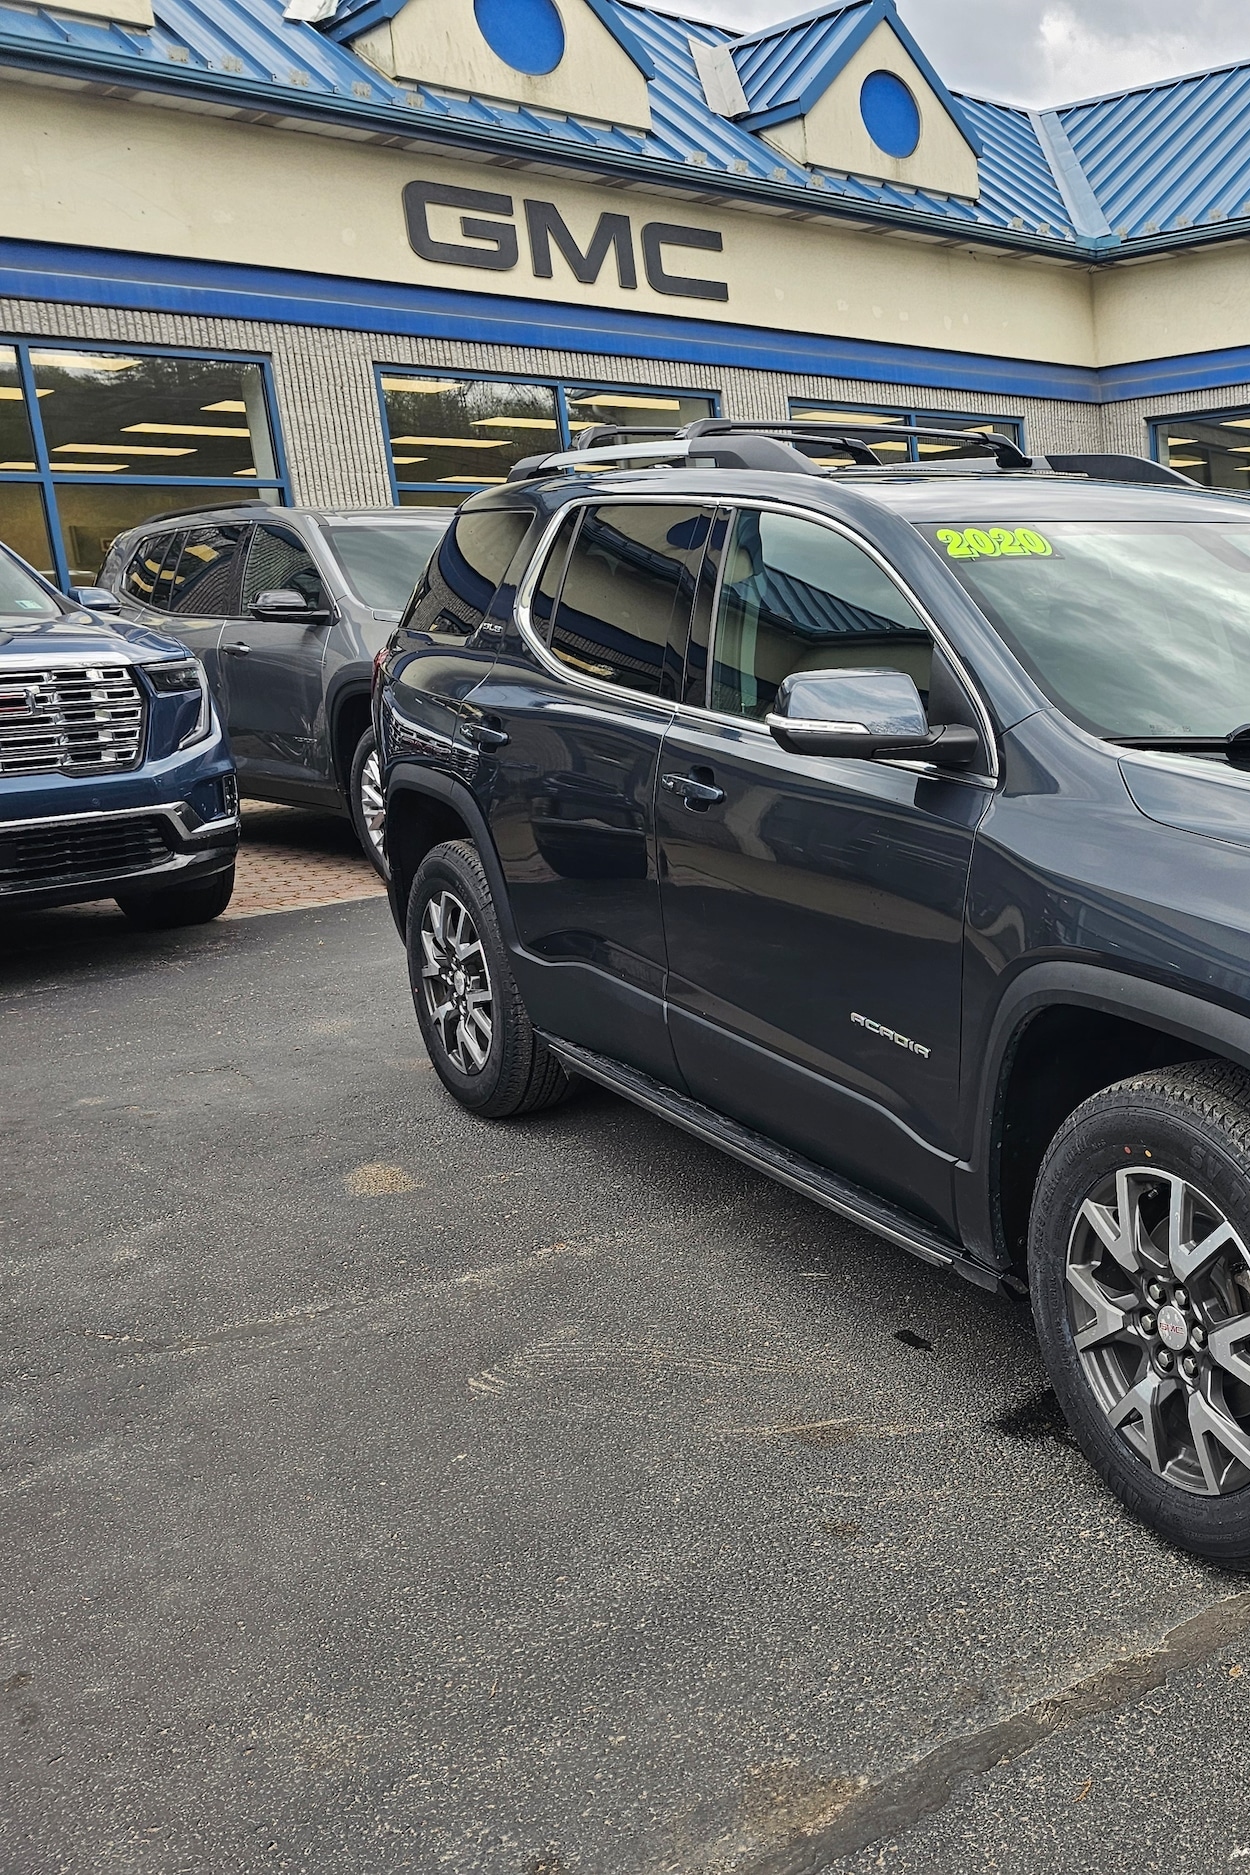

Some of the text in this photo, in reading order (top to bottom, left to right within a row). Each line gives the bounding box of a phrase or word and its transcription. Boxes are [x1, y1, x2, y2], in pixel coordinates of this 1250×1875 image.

[401, 180, 729, 302] GMC
[936, 527, 1053, 559] 2020
[850, 1011, 932, 1059] ACADIA
[1159, 1322, 1185, 1336] GMC
